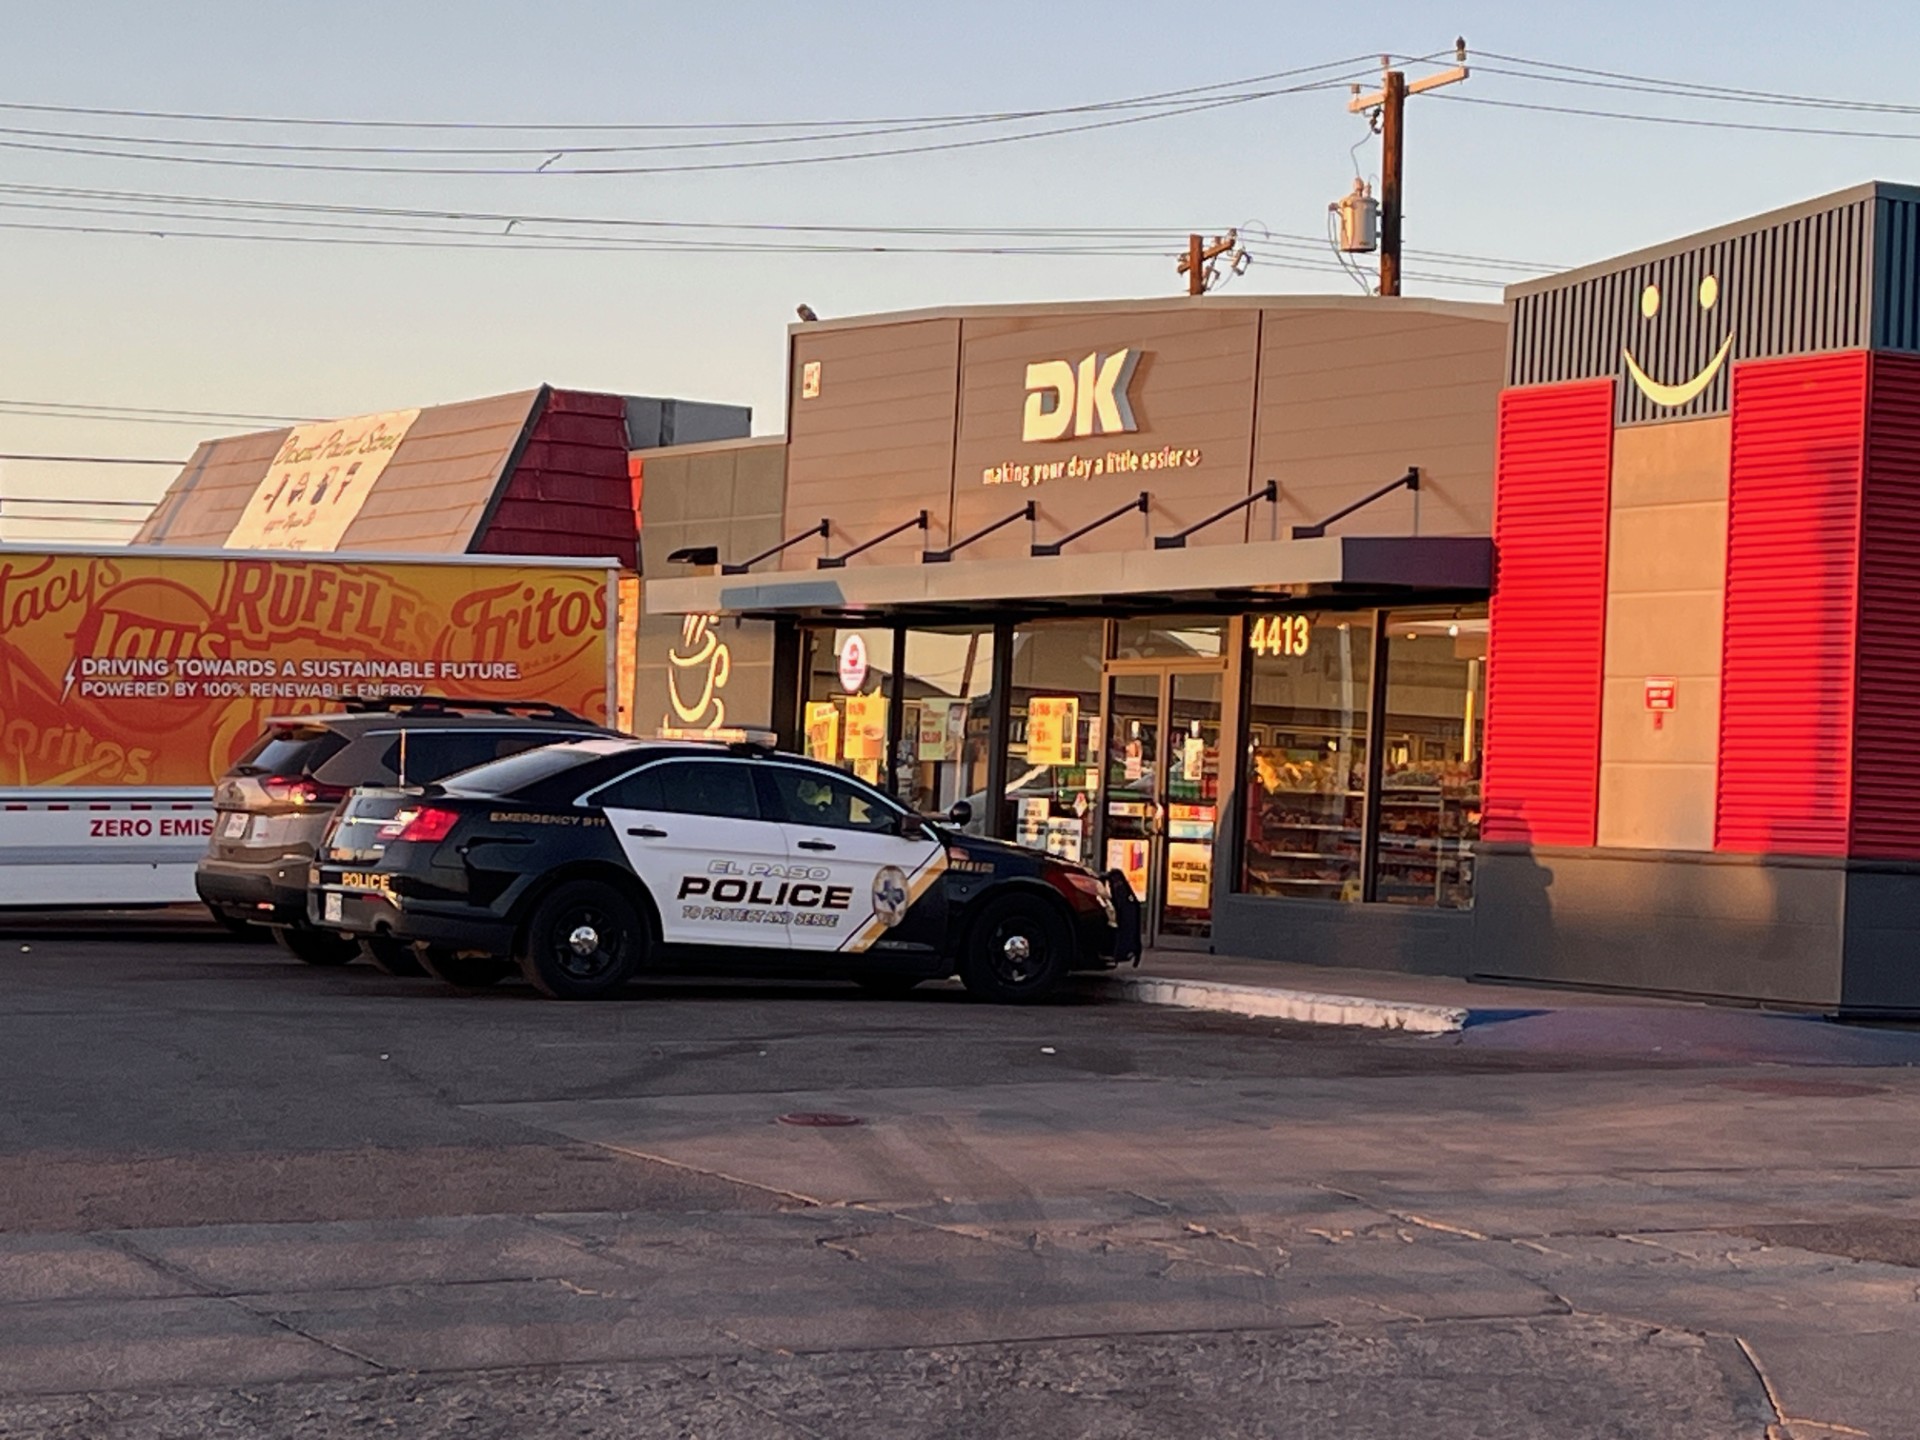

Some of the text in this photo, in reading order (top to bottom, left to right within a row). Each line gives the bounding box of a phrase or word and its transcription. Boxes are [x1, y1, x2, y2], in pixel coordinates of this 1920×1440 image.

[1022, 347, 1138, 442] DK
[982, 446, 1184, 487] making your day a little easier
[226, 560, 440, 657] RUFFLES
[451, 581, 607, 668] Fritos
[1250, 615, 1309, 656] 4413
[81, 658, 521, 680] DRIVING TOWARDS A SUSTAINABLE FUTURE.
[81, 682, 424, 698] POWERED BY 100% RENEWABLE ENERGY
[0, 717, 152, 785] oritos
[90, 819, 152, 837] ZERO
[490, 811, 606, 828] EMERGENCY 911
[342, 871, 391, 891] POLICE
[708, 859, 831, 882] EL PASO
[677, 875, 854, 911] POLICE
[682, 905, 840, 928] TO PROTECT AND SERVE
